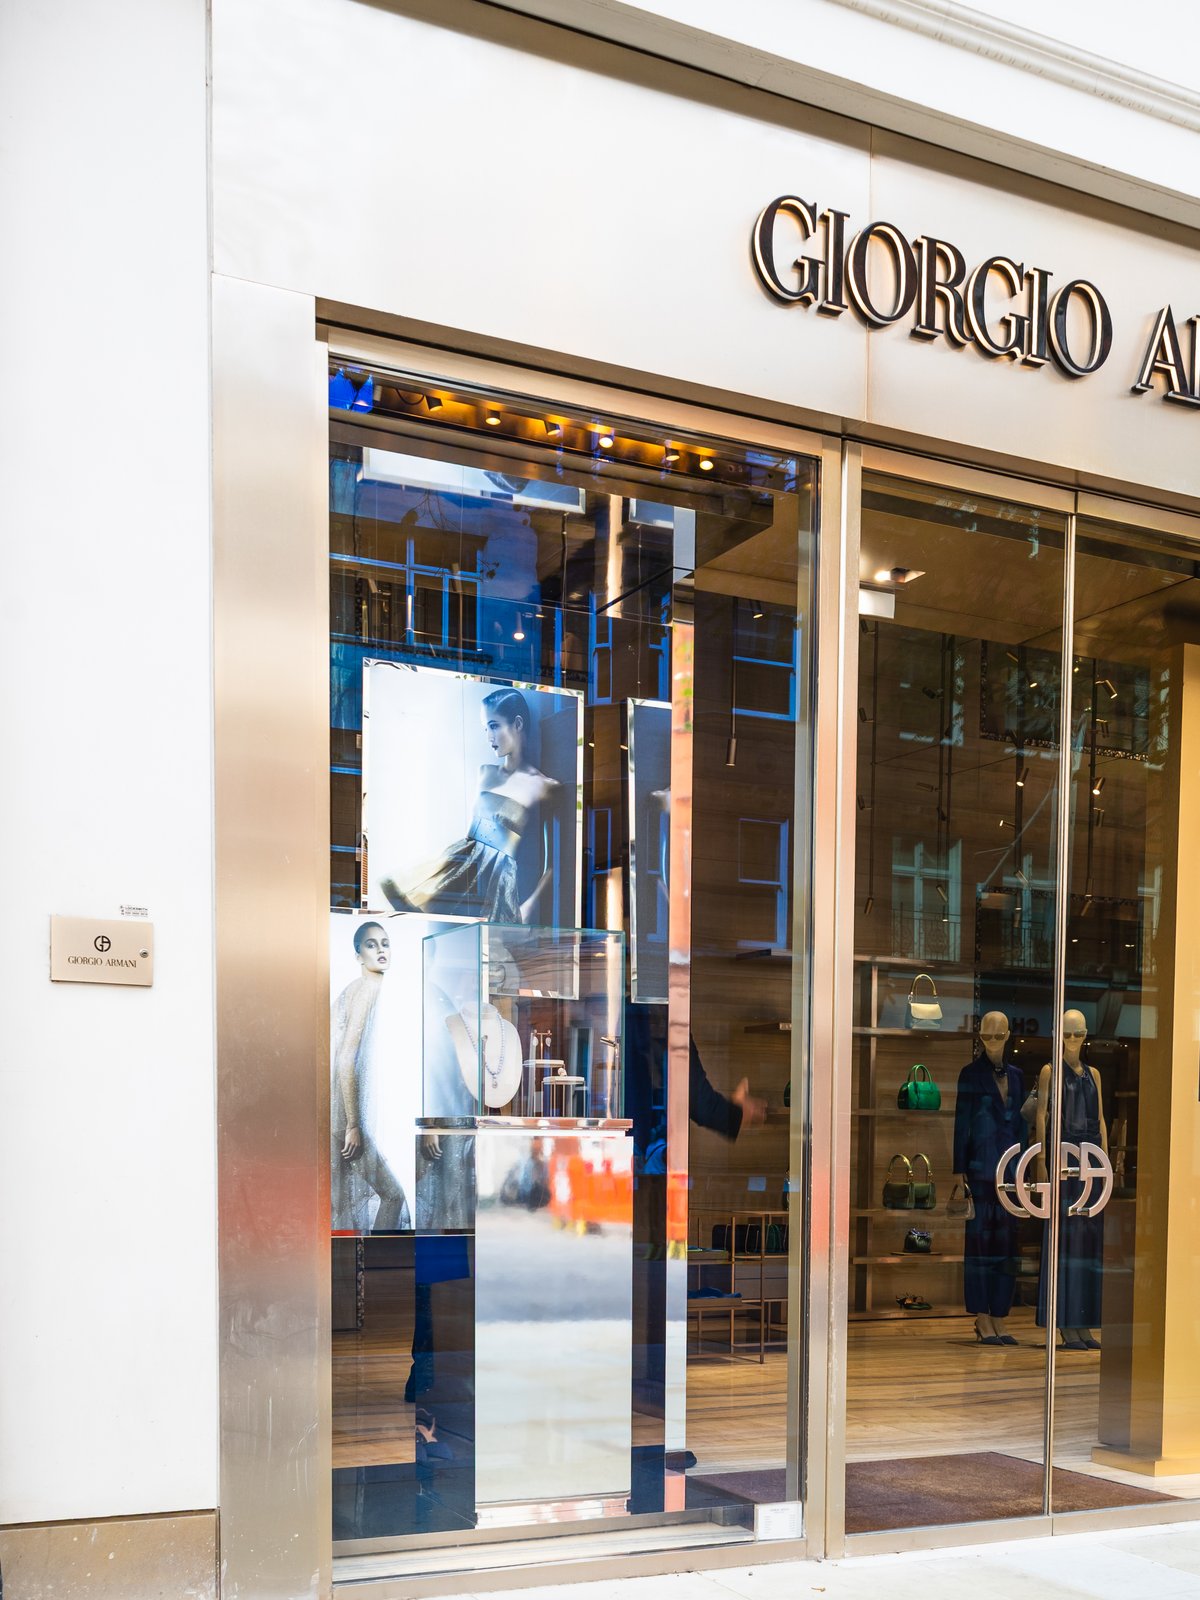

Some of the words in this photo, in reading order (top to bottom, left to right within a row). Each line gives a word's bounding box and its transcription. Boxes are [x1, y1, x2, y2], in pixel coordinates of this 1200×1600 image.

[751, 194, 1114, 379] GIORGIO
[67, 955, 103, 966] GIORGIO
[105, 958, 137, 968] ARMANI
